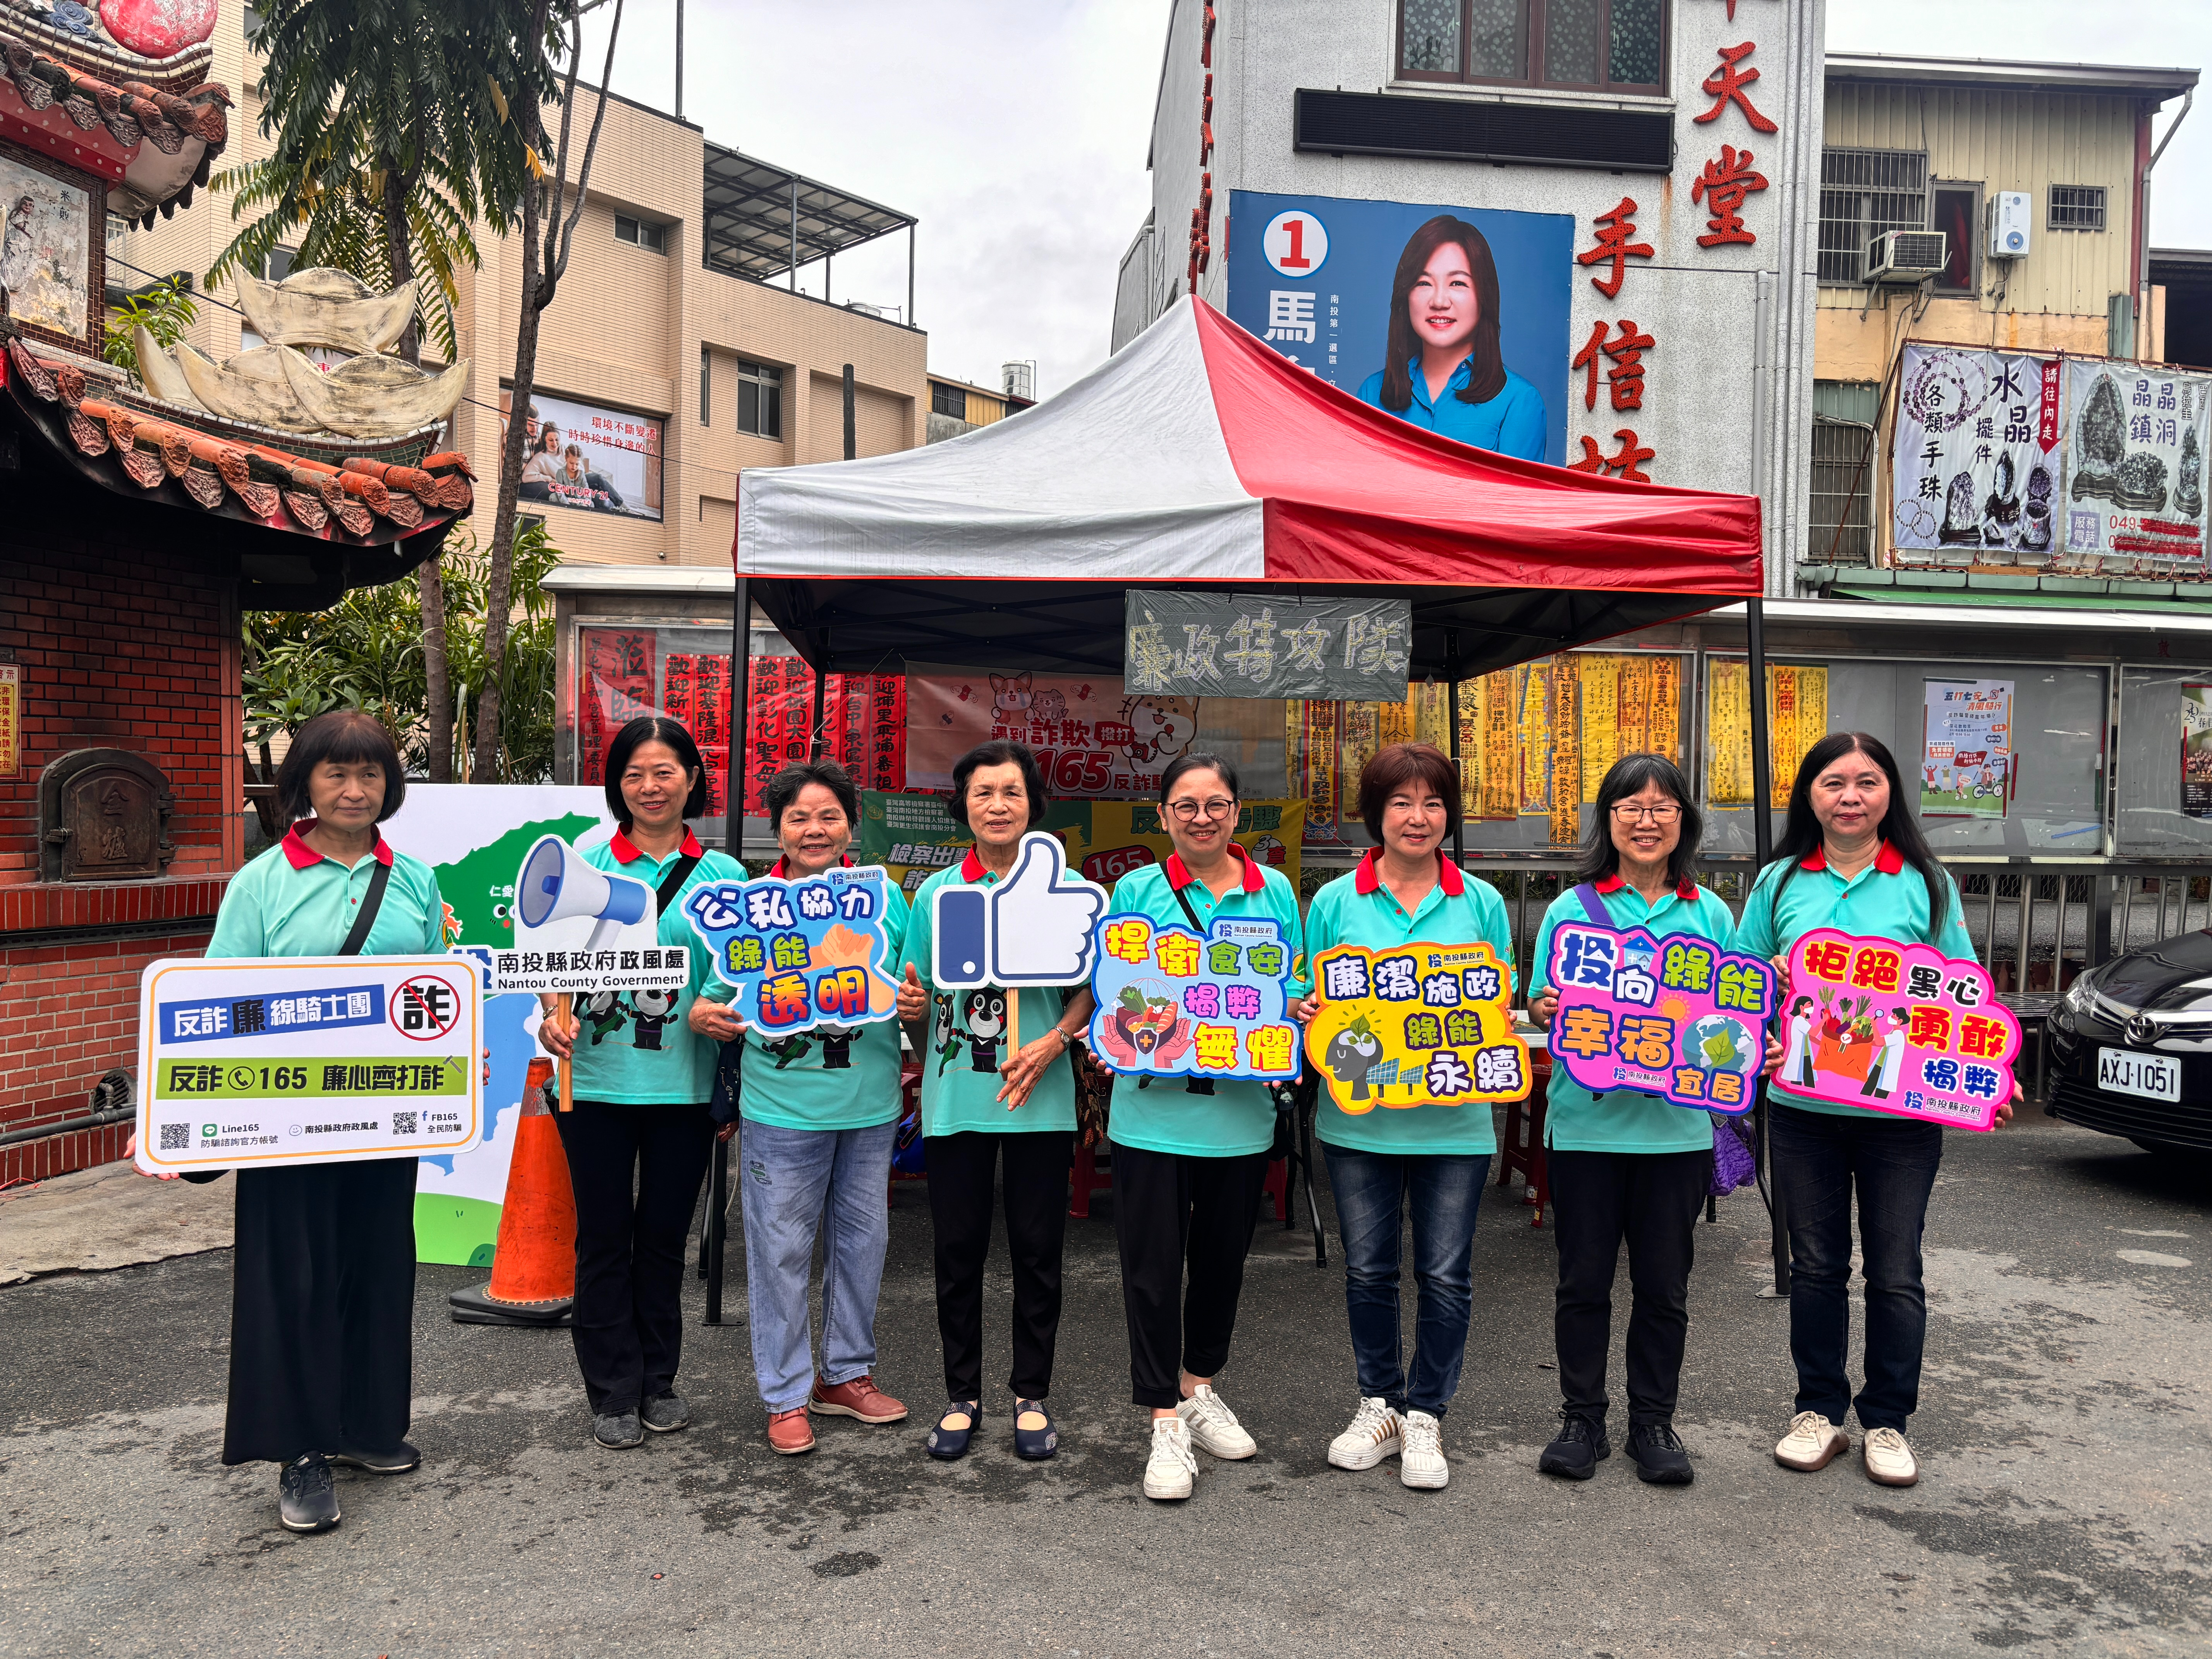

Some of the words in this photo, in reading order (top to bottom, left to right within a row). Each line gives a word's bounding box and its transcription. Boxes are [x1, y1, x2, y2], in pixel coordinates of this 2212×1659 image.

[1691, 0, 1779, 248] 天堂
[1280, 220, 1310, 268] 1
[1263, 290, 1316, 375] 馬
[1990, 362, 2031, 443] 水晶
[2042, 368, 2057, 440] 請往內走
[2130, 379, 2152, 444] 晶鎮
[2156, 383, 2176, 446] 晶洞
[568, 429, 657, 455] 時時珍惜身邊的人
[591, 416, 657, 440] 環境不斷變遷
[1918, 384, 1944, 503] 各類手珠
[1975, 417, 1993, 464] 擺件
[548, 483, 598, 498] CENTURY
[599, 491, 609, 500] 21
[2074, 530, 2095, 543] 電話
[2075, 516, 2096, 529] 服務
[1129, 608, 1403, 690] 廉政特攻隊
[587, 637, 603, 786] 草屯敦和宮管理委員
[665, 656, 690, 723] 歡迎新北
[842, 674, 867, 787] 迎台中東區東
[873, 675, 897, 791] 迎埔里平埔番祖
[991, 717, 1091, 748] 遇到詐欺
[1101, 726, 1130, 741] 撥打
[1035, 749, 1114, 793] 165
[1091, 850, 1146, 879] 165
[489, 884, 514, 898] 仁愛
[695, 885, 873, 929] 公私協力
[498, 950, 684, 974] 南投縣政府政風處
[728, 936, 808, 971] 綠能
[1106, 920, 1283, 977] 捍衛食安
[1444, 952, 1484, 961] 南投縣政府
[498, 978, 546, 989] Nantou
[551, 976, 598, 989] County
[603, 974, 684, 986] Government
[1326, 957, 1499, 1004] 廉潔施政
[1561, 933, 1763, 1010] 投向綠能
[1805, 941, 1980, 1006] 拒絕黑心
[174, 991, 371, 1037] 反詐廉線騎士團
[403, 985, 450, 1030] 詐
[761, 969, 865, 1024] 透明
[1185, 983, 1261, 1020] 揭弊
[1194, 1023, 1293, 1072] 無懼
[1407, 1014, 1480, 1047] 綠能
[1562, 1008, 1671, 1068] 幸福
[1909, 1006, 2009, 1060] 勇敢
[169, 1065, 223, 1092] 反詐
[260, 1067, 307, 1090] 165
[322, 1065, 444, 1091] 廉心齊打詐
[1430, 1049, 1520, 1093] 永續
[1628, 1071, 1665, 1083] 南投縣政府
[1676, 1068, 1741, 1102] 宜居
[1924, 1060, 1999, 1097] 揭弊
[305, 1121, 378, 1134] 南投縣政府政風處
[432, 1113, 458, 1121] FB165
[1927, 1097, 1981, 1115] 南投縣政府
[201, 1135, 278, 1148] 防騙諮詢官方帳號
[222, 1124, 259, 1133] Line165
[427, 1124, 462, 1133] 全民防騙
